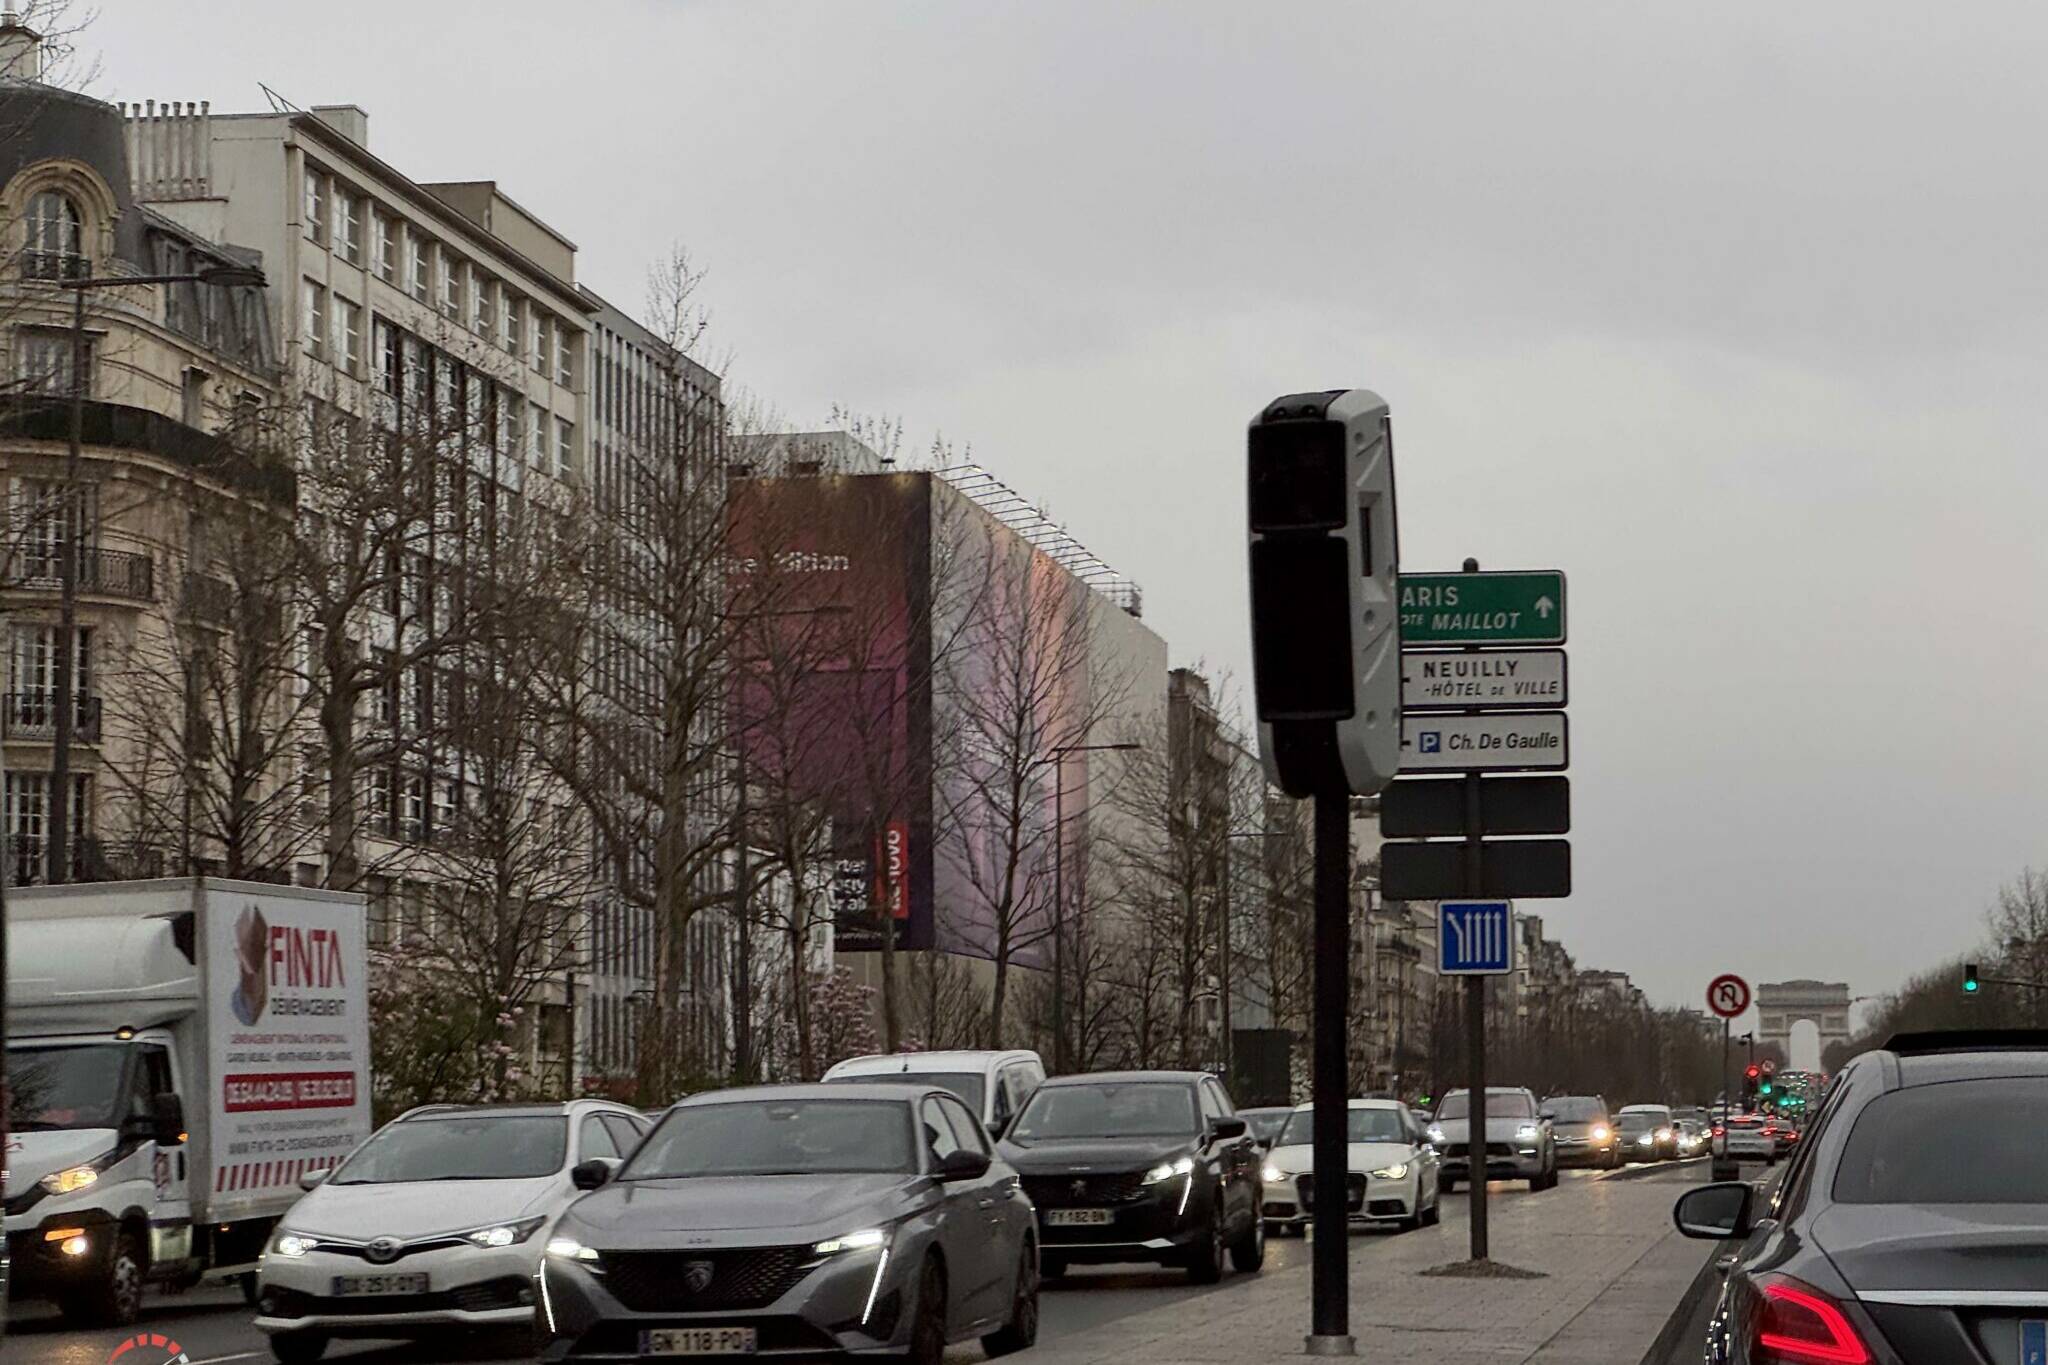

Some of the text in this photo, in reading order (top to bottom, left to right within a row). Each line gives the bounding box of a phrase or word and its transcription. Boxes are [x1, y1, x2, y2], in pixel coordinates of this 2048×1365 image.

[1401, 586, 1458, 607] ARIS
[1432, 612, 1520, 631] MAILLOT
[1424, 660, 1518, 678] NEUILLY
[1514, 680, 1558, 695] VILLE
[1449, 733, 1474, 750] Ch.
[1479, 733, 1502, 749] De
[1506, 731, 1558, 748] Gaulle
[269, 926, 346, 988] FINTA
